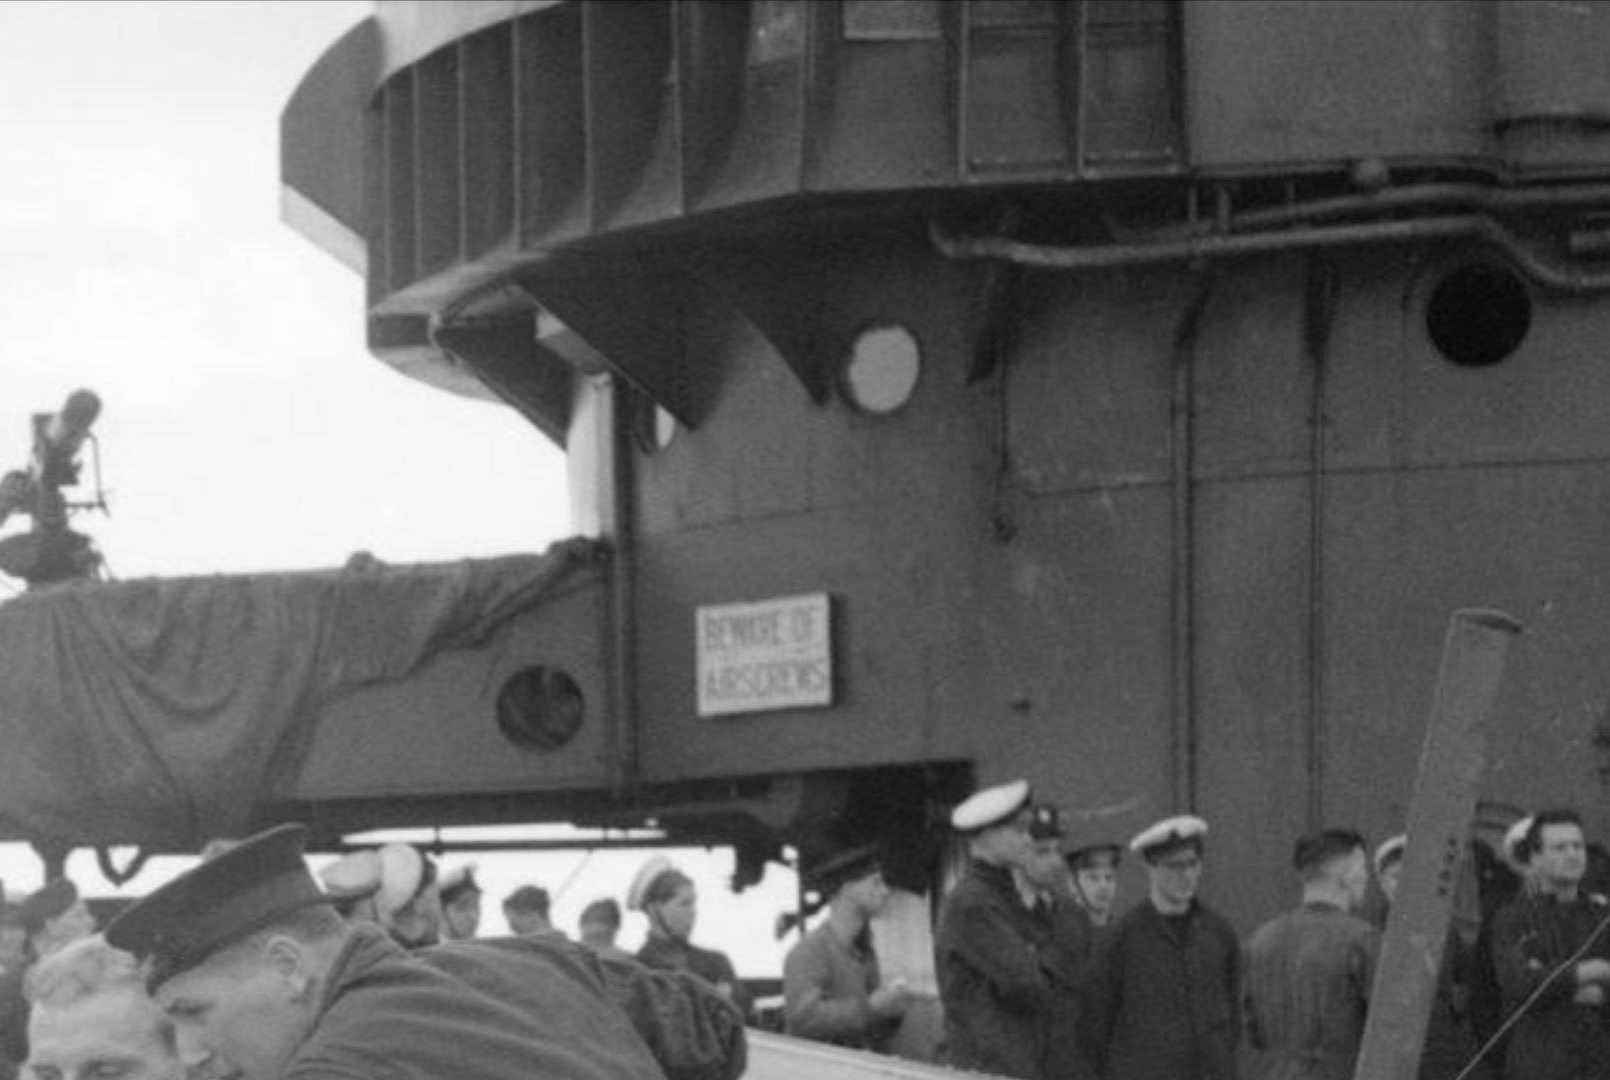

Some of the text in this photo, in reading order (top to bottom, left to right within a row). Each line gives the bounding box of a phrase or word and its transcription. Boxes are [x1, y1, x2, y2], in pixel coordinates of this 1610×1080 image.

[705, 603, 817, 651] BEWARE OF
[705, 656, 827, 700] AIRSCREWS
